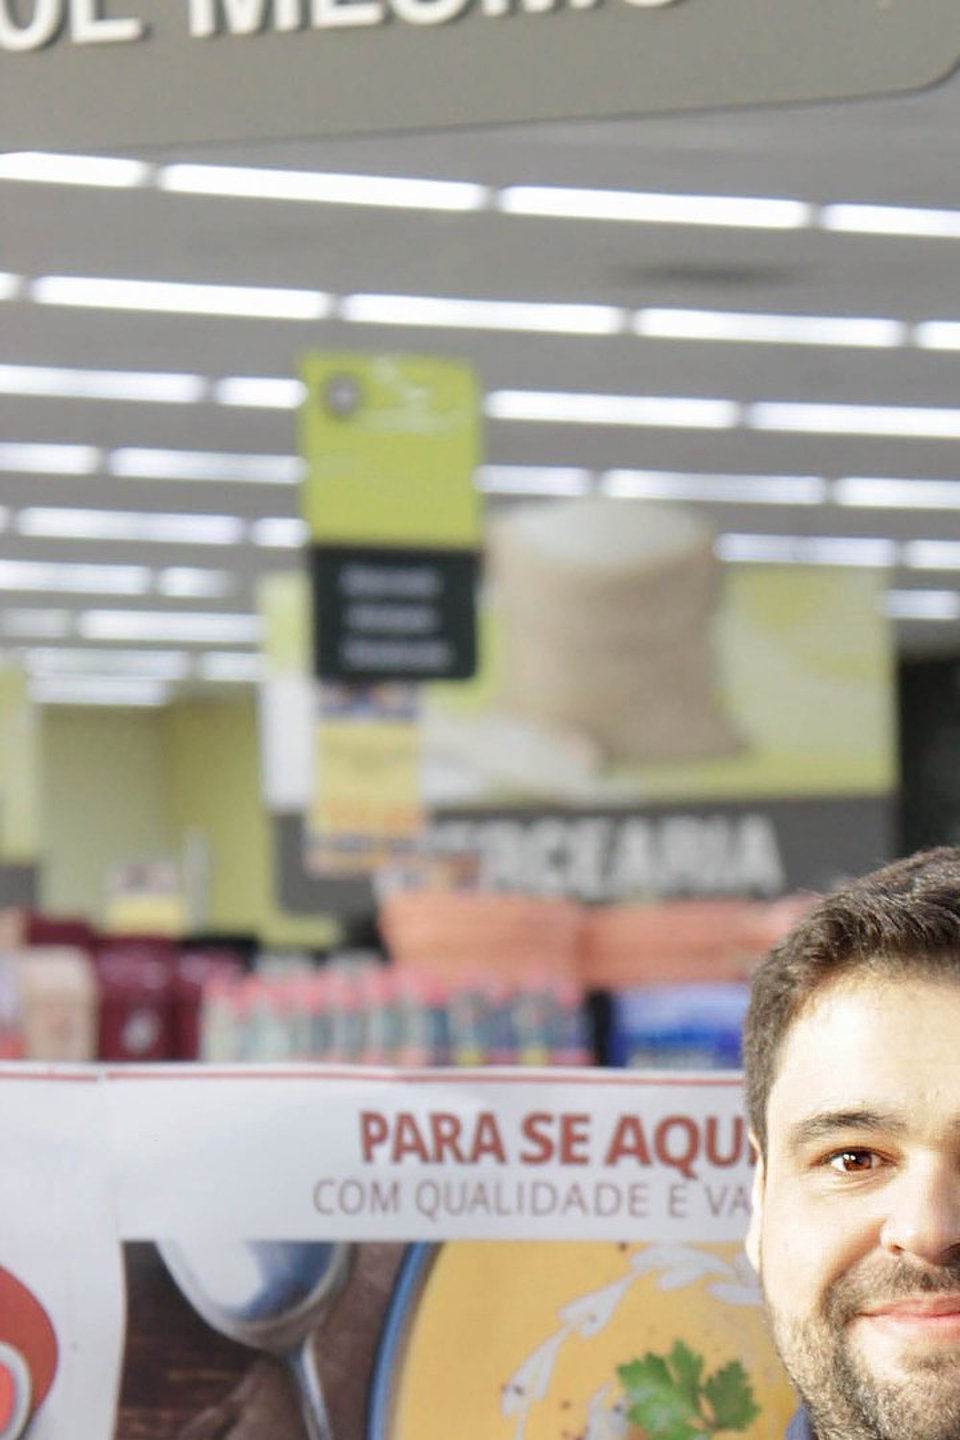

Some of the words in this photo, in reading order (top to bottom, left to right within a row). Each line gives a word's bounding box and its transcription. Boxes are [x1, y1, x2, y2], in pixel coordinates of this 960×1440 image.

[358, 1111, 507, 1164] PARA
[519, 1112, 591, 1167] SE
[604, 1113, 757, 1180] AQU
[312, 1178, 400, 1216] COM
[414, 1181, 651, 1222] QUALIDADE
[666, 1182, 689, 1217] E
